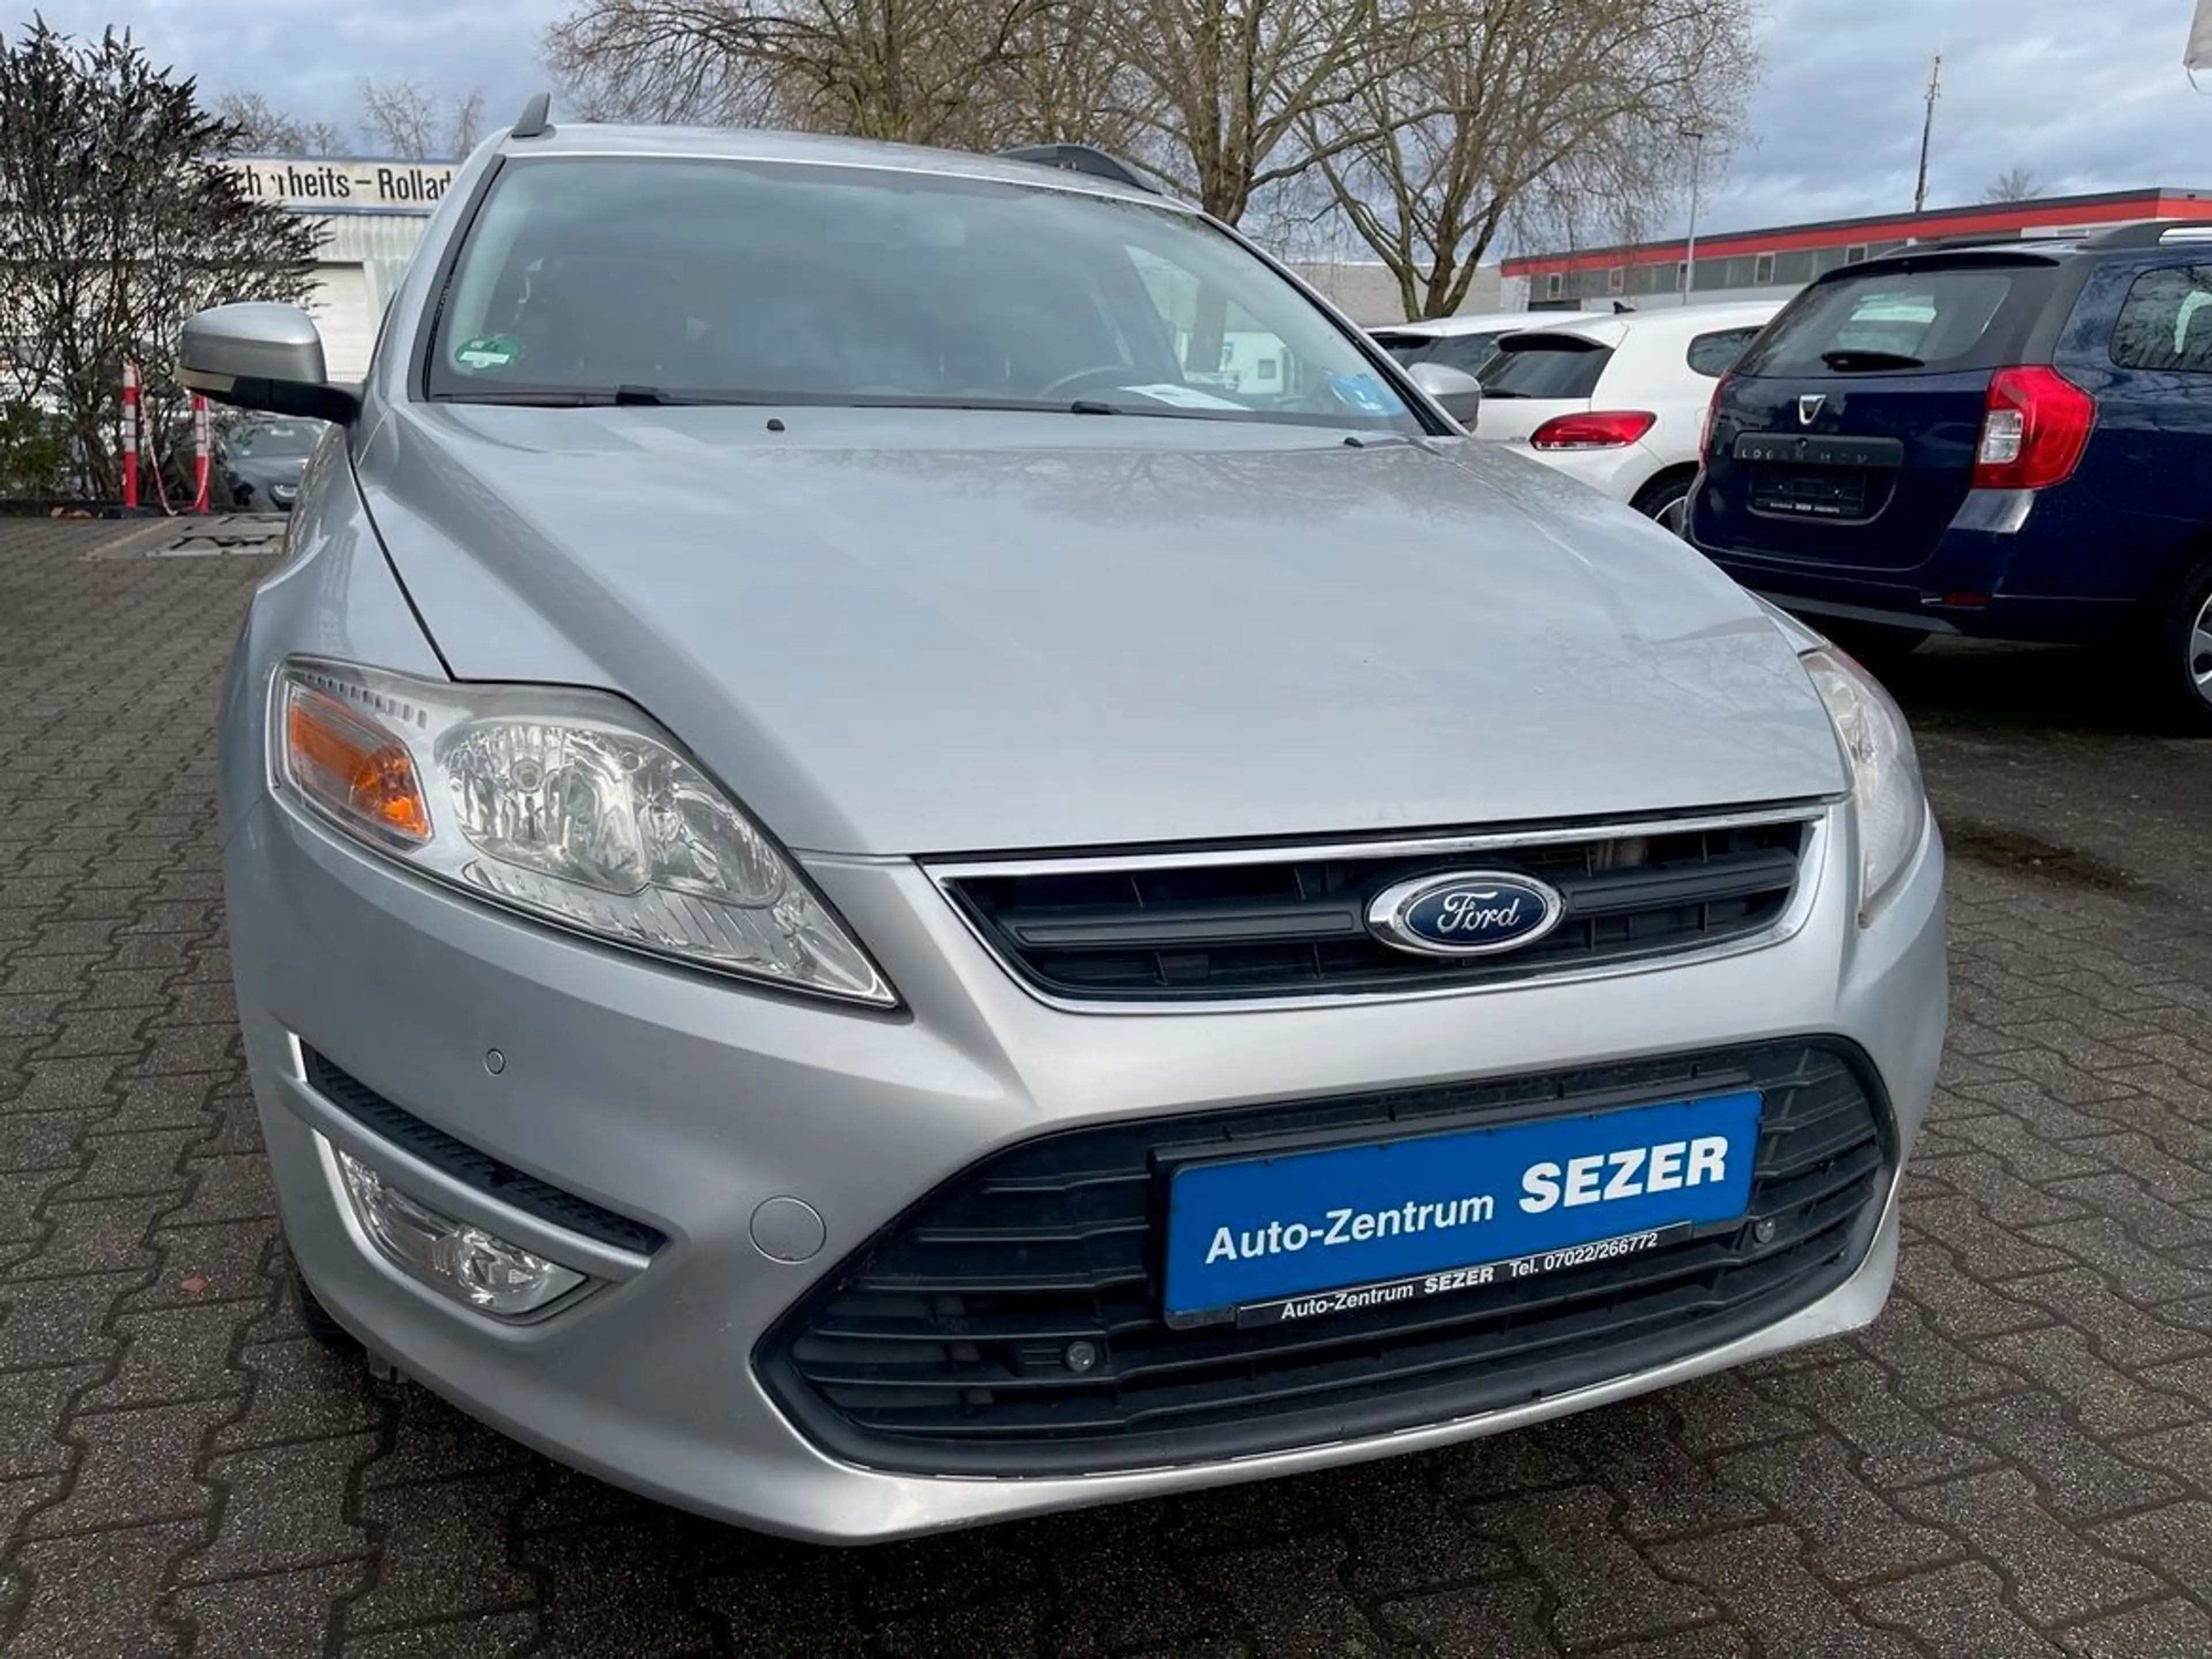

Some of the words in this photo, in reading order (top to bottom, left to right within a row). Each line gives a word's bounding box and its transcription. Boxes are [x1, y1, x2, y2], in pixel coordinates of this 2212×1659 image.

[1437, 891, 1520, 934] Ford
[1206, 1195, 1494, 1264] Auto-Zentrum
[1519, 1136, 1729, 1213] SEZER
[1281, 1284, 1414, 1320] Auto-Zentrum
[1424, 1266, 1494, 1294] SEZER
[1509, 1257, 1539, 1278] Tel.
[1544, 1232, 1658, 1270] 07022/266772
